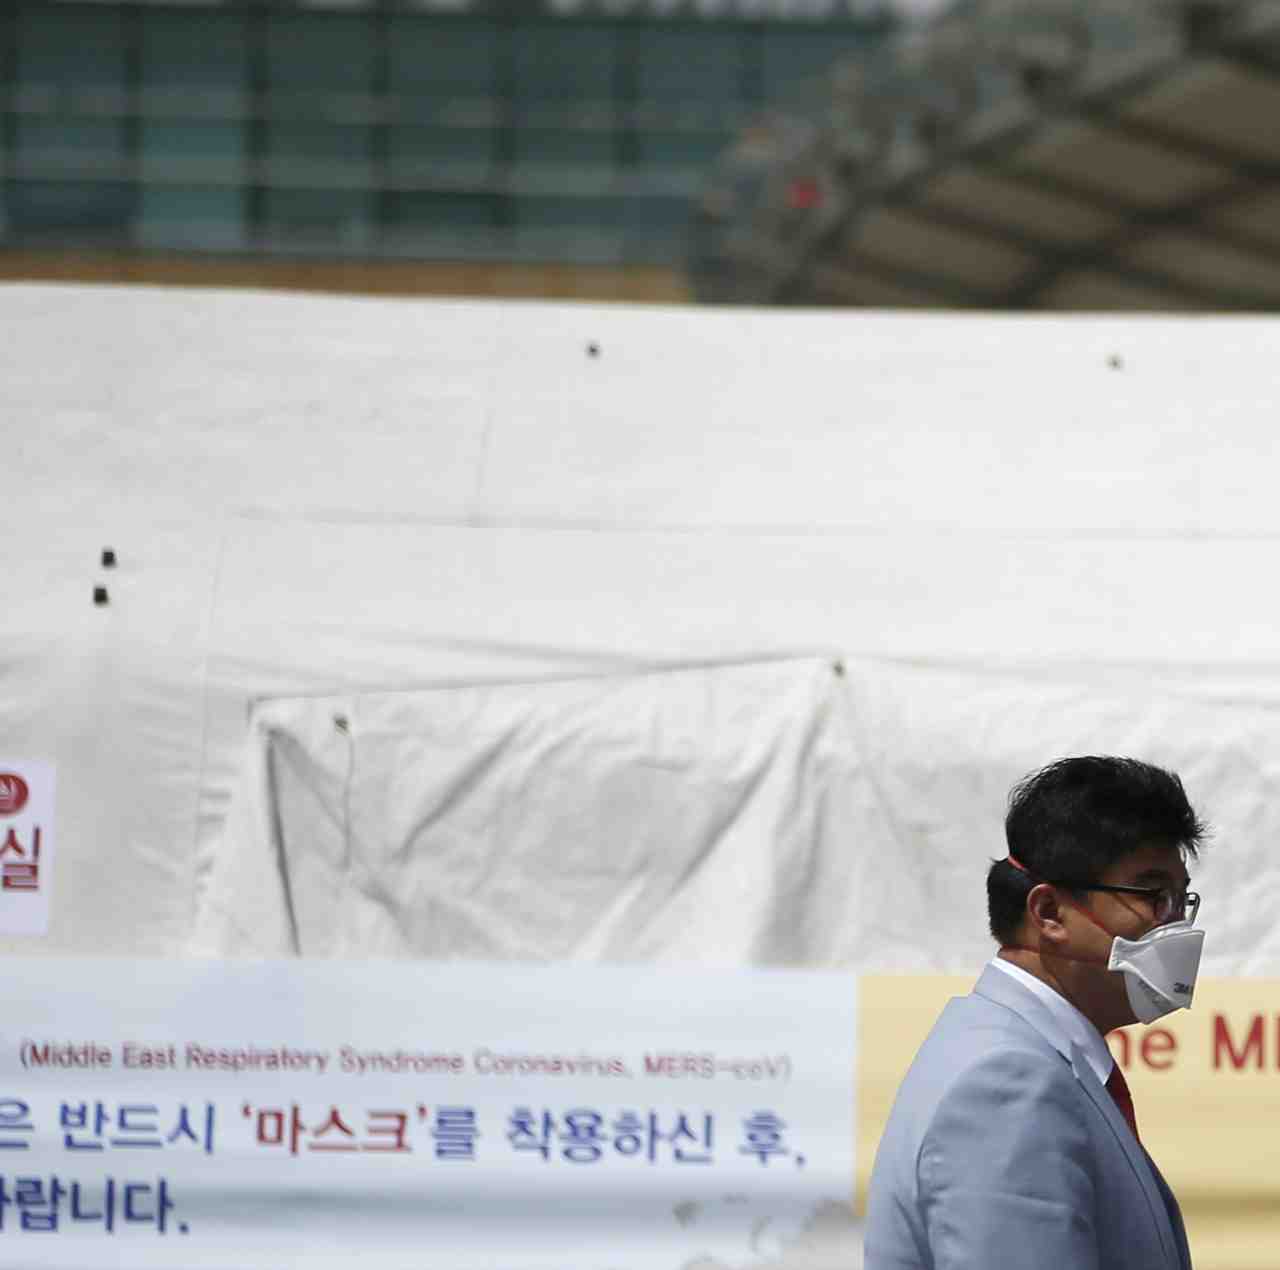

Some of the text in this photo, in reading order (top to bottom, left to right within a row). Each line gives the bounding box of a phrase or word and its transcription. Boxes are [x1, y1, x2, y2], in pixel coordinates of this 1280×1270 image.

[122, 1044, 178, 1070] East
[185, 1043, 330, 1074] Respiratory
[338, 1047, 465, 1076] Syndrome
[59, 1100, 215, 1154] 반드시
[507, 1106, 714, 1164] 착용하신
